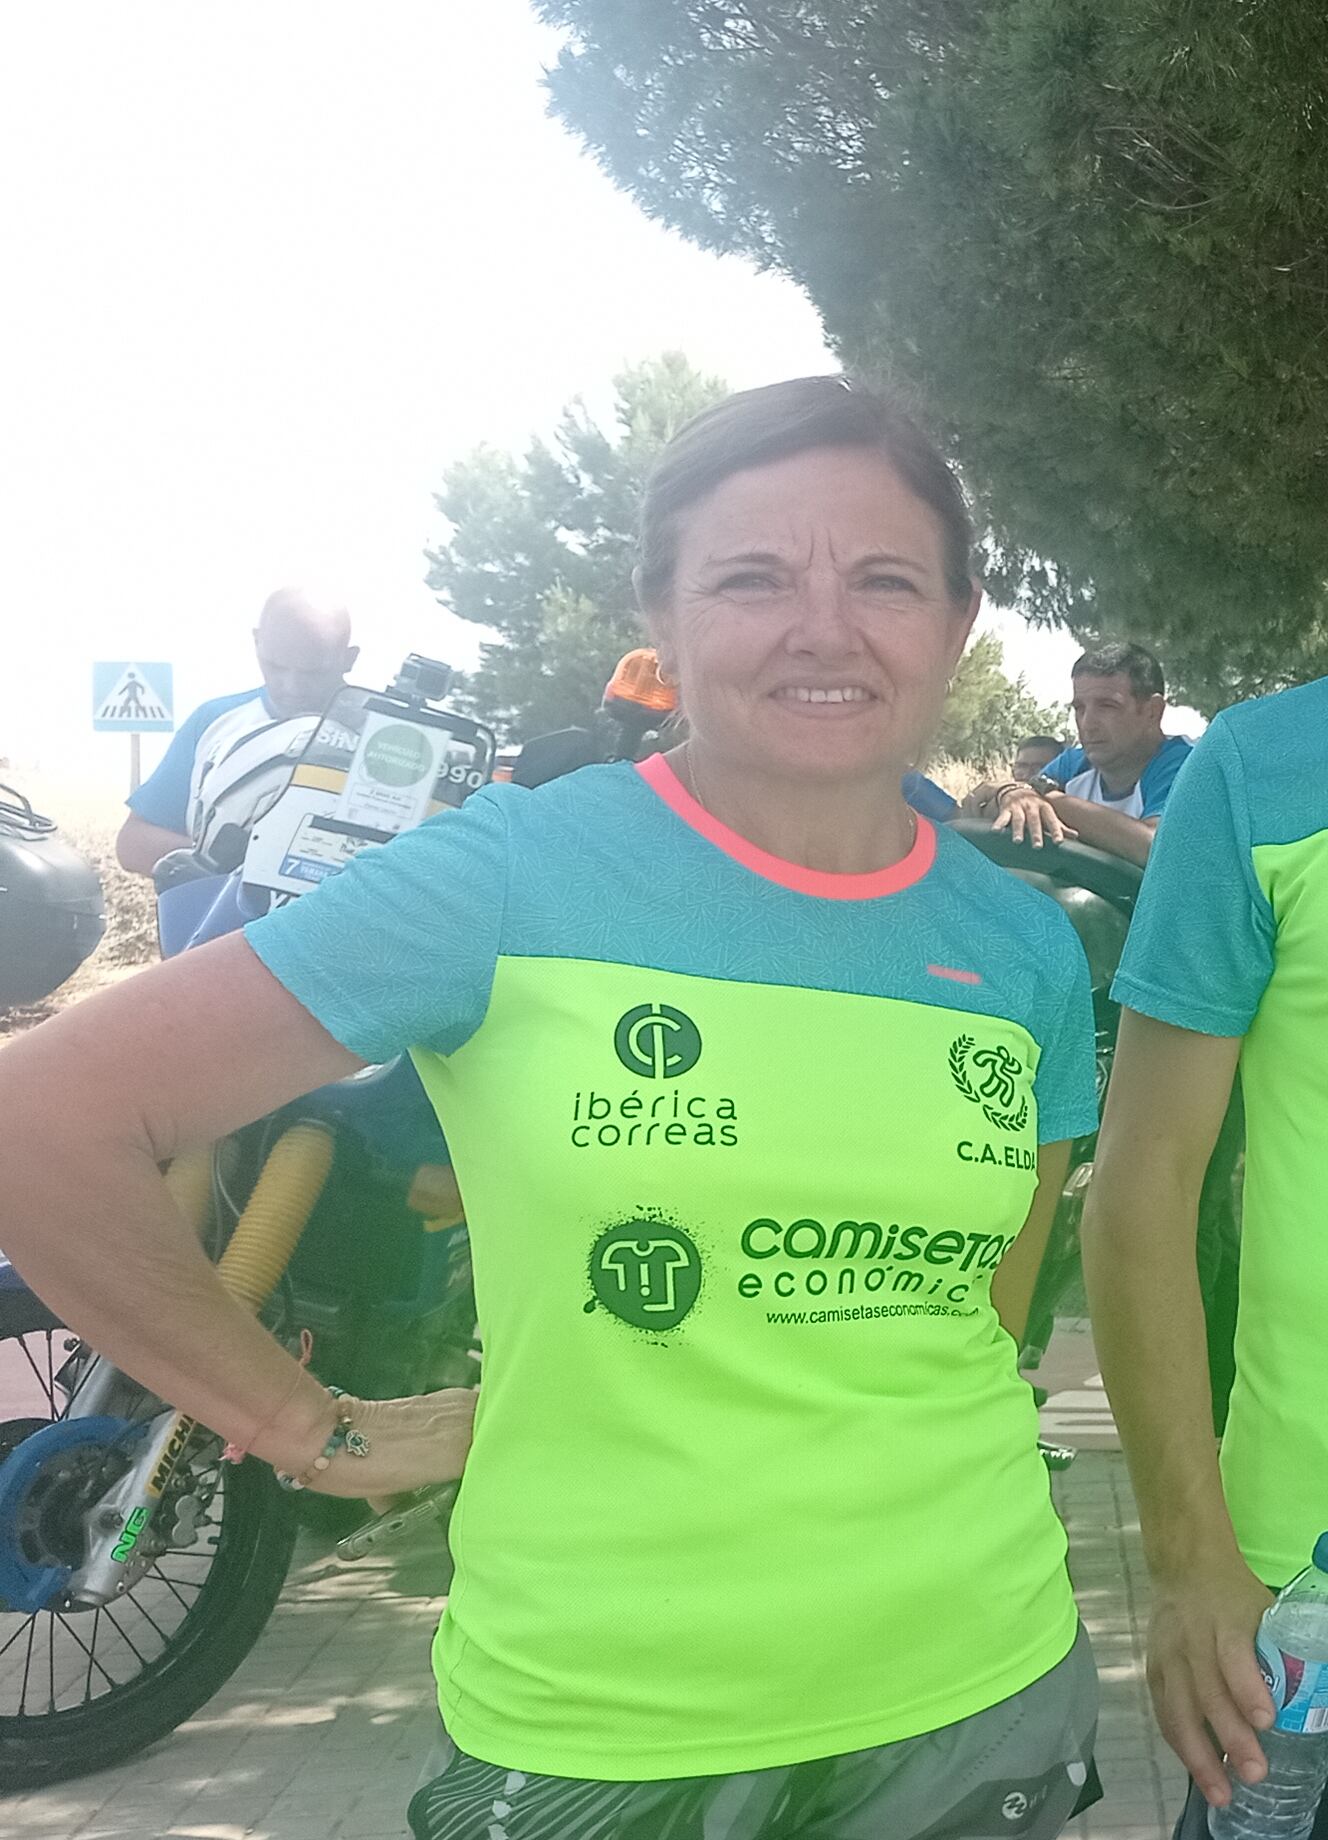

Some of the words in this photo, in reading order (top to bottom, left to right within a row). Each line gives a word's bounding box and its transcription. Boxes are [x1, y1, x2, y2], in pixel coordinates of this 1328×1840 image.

[285, 859, 300, 875] 7
[572, 1089, 738, 1121] ibérica
[571, 1121, 738, 1148] correas
[766, 1302, 980, 1325] www.camisetaseconomicas.
[151, 1414, 195, 1491] MICH
